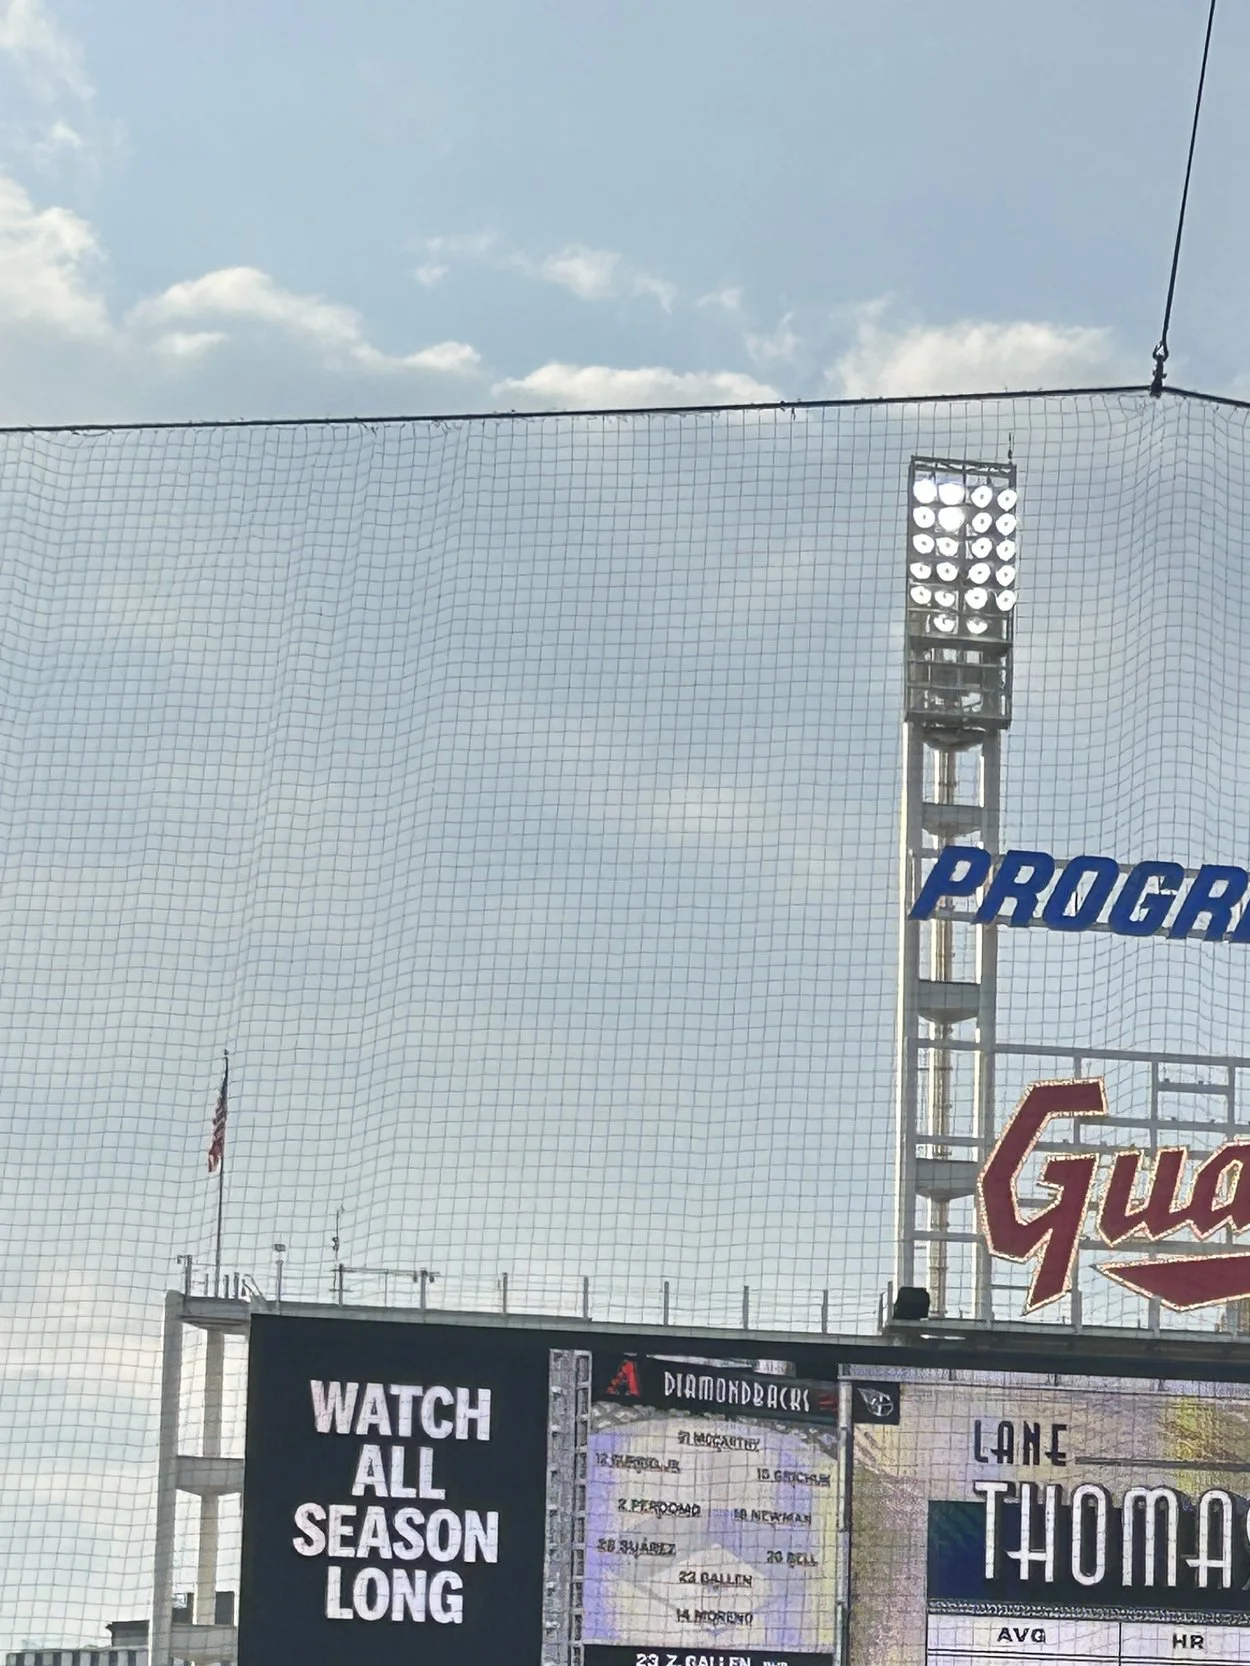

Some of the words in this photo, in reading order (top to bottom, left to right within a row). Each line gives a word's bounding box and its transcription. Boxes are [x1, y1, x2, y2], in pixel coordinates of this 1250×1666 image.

[311, 1379, 492, 1441] WATCH
[974, 1419, 1068, 1466] LANE
[352, 1445, 446, 1501] ALL
[292, 1502, 499, 1564] SEASON
[326, 1565, 465, 1624] LONG
[997, 1627, 1046, 1645] AVG
[1172, 1633, 1204, 1650] HR
